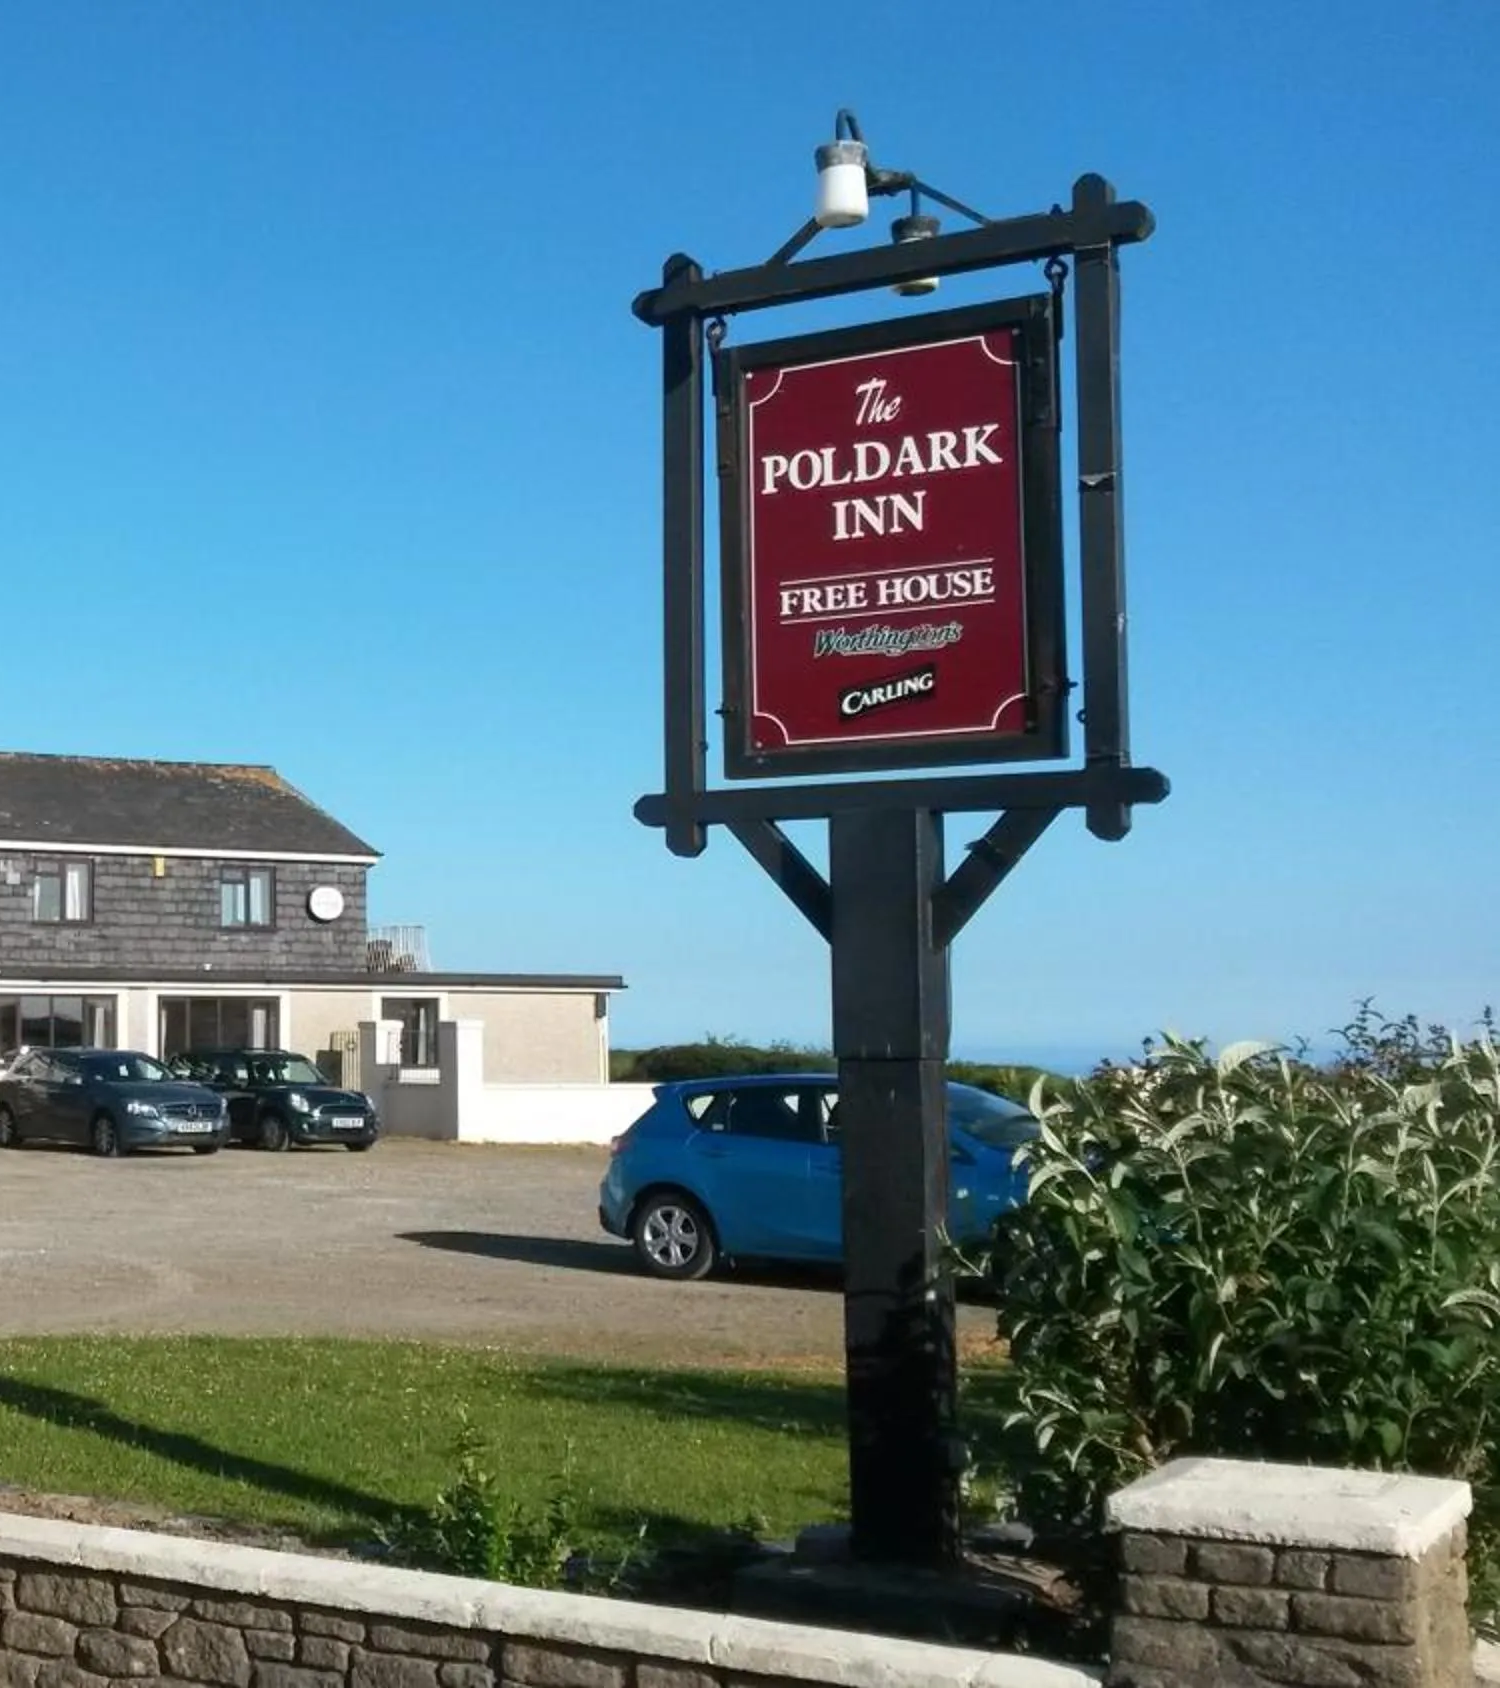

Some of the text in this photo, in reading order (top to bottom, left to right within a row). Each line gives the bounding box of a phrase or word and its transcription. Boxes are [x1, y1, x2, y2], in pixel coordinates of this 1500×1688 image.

[855, 377, 901, 426] The
[760, 423, 1003, 495] POLDARK
[832, 490, 926, 541] INN
[780, 568, 996, 616] FREE HOUSE
[841, 673, 934, 715] CARLING
